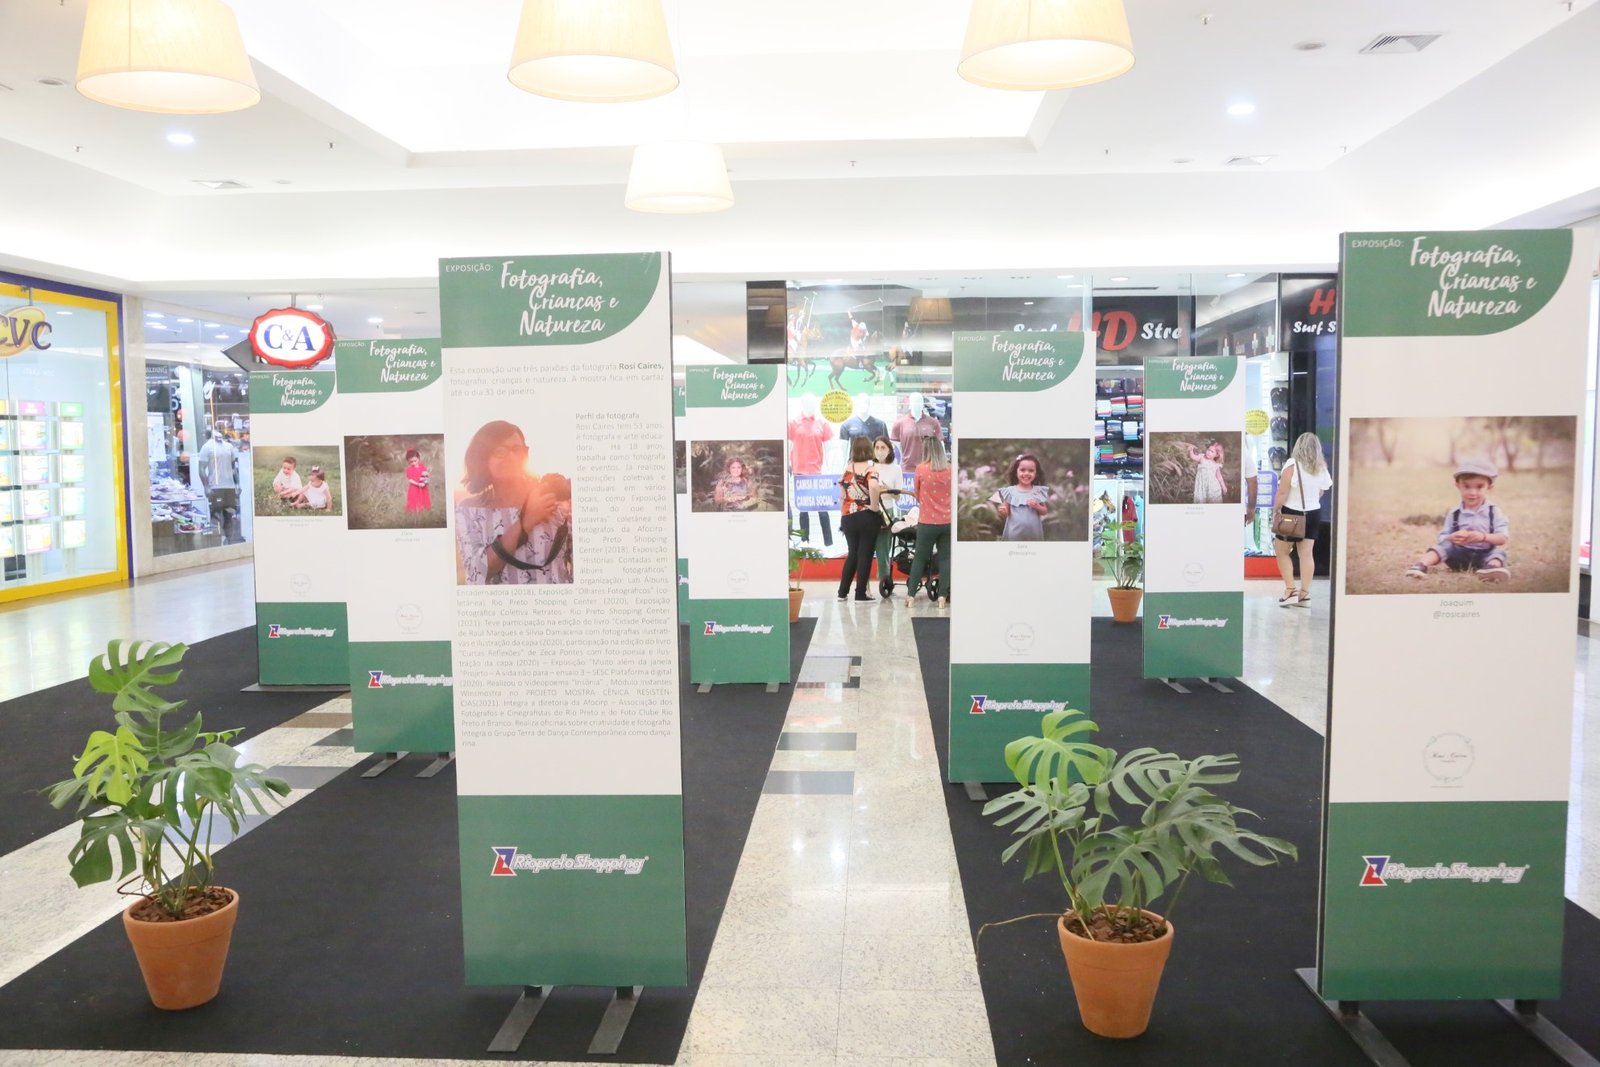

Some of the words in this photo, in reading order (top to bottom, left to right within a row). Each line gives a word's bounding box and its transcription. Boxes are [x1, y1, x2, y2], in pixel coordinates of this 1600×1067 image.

[1410, 236, 1521, 273] Fotografia,
[501, 260, 603, 291] Fotografia,
[1440, 266, 1521, 293] Crianças
[1526, 276, 1537, 290] e
[529, 286, 606, 311] Crianças
[609, 296, 619, 309] e
[1428, 289, 1520, 319] Natureza
[520, 310, 606, 337] Natureza
[1293, 320, 1323, 335] Surf
[263, 324, 317, 352] C&A
[992, 335, 1056, 358] Fotografia,
[370, 340, 428, 362] Fotografia,
[638, 362, 664, 371] Caires,
[713, 366, 758, 383] Fotografia,
[1003, 365, 1055, 382] Natureza
[1172, 358, 1217, 374] Fotografia,
[272, 373, 318, 391] Fotografia,
[381, 369, 430, 384] Natureza
[1180, 378, 1217, 392] Natureza
[280, 394, 318, 408] Natureza
[721, 388, 759, 401] Natureza
[1439, 600, 1474, 608] Joaquim
